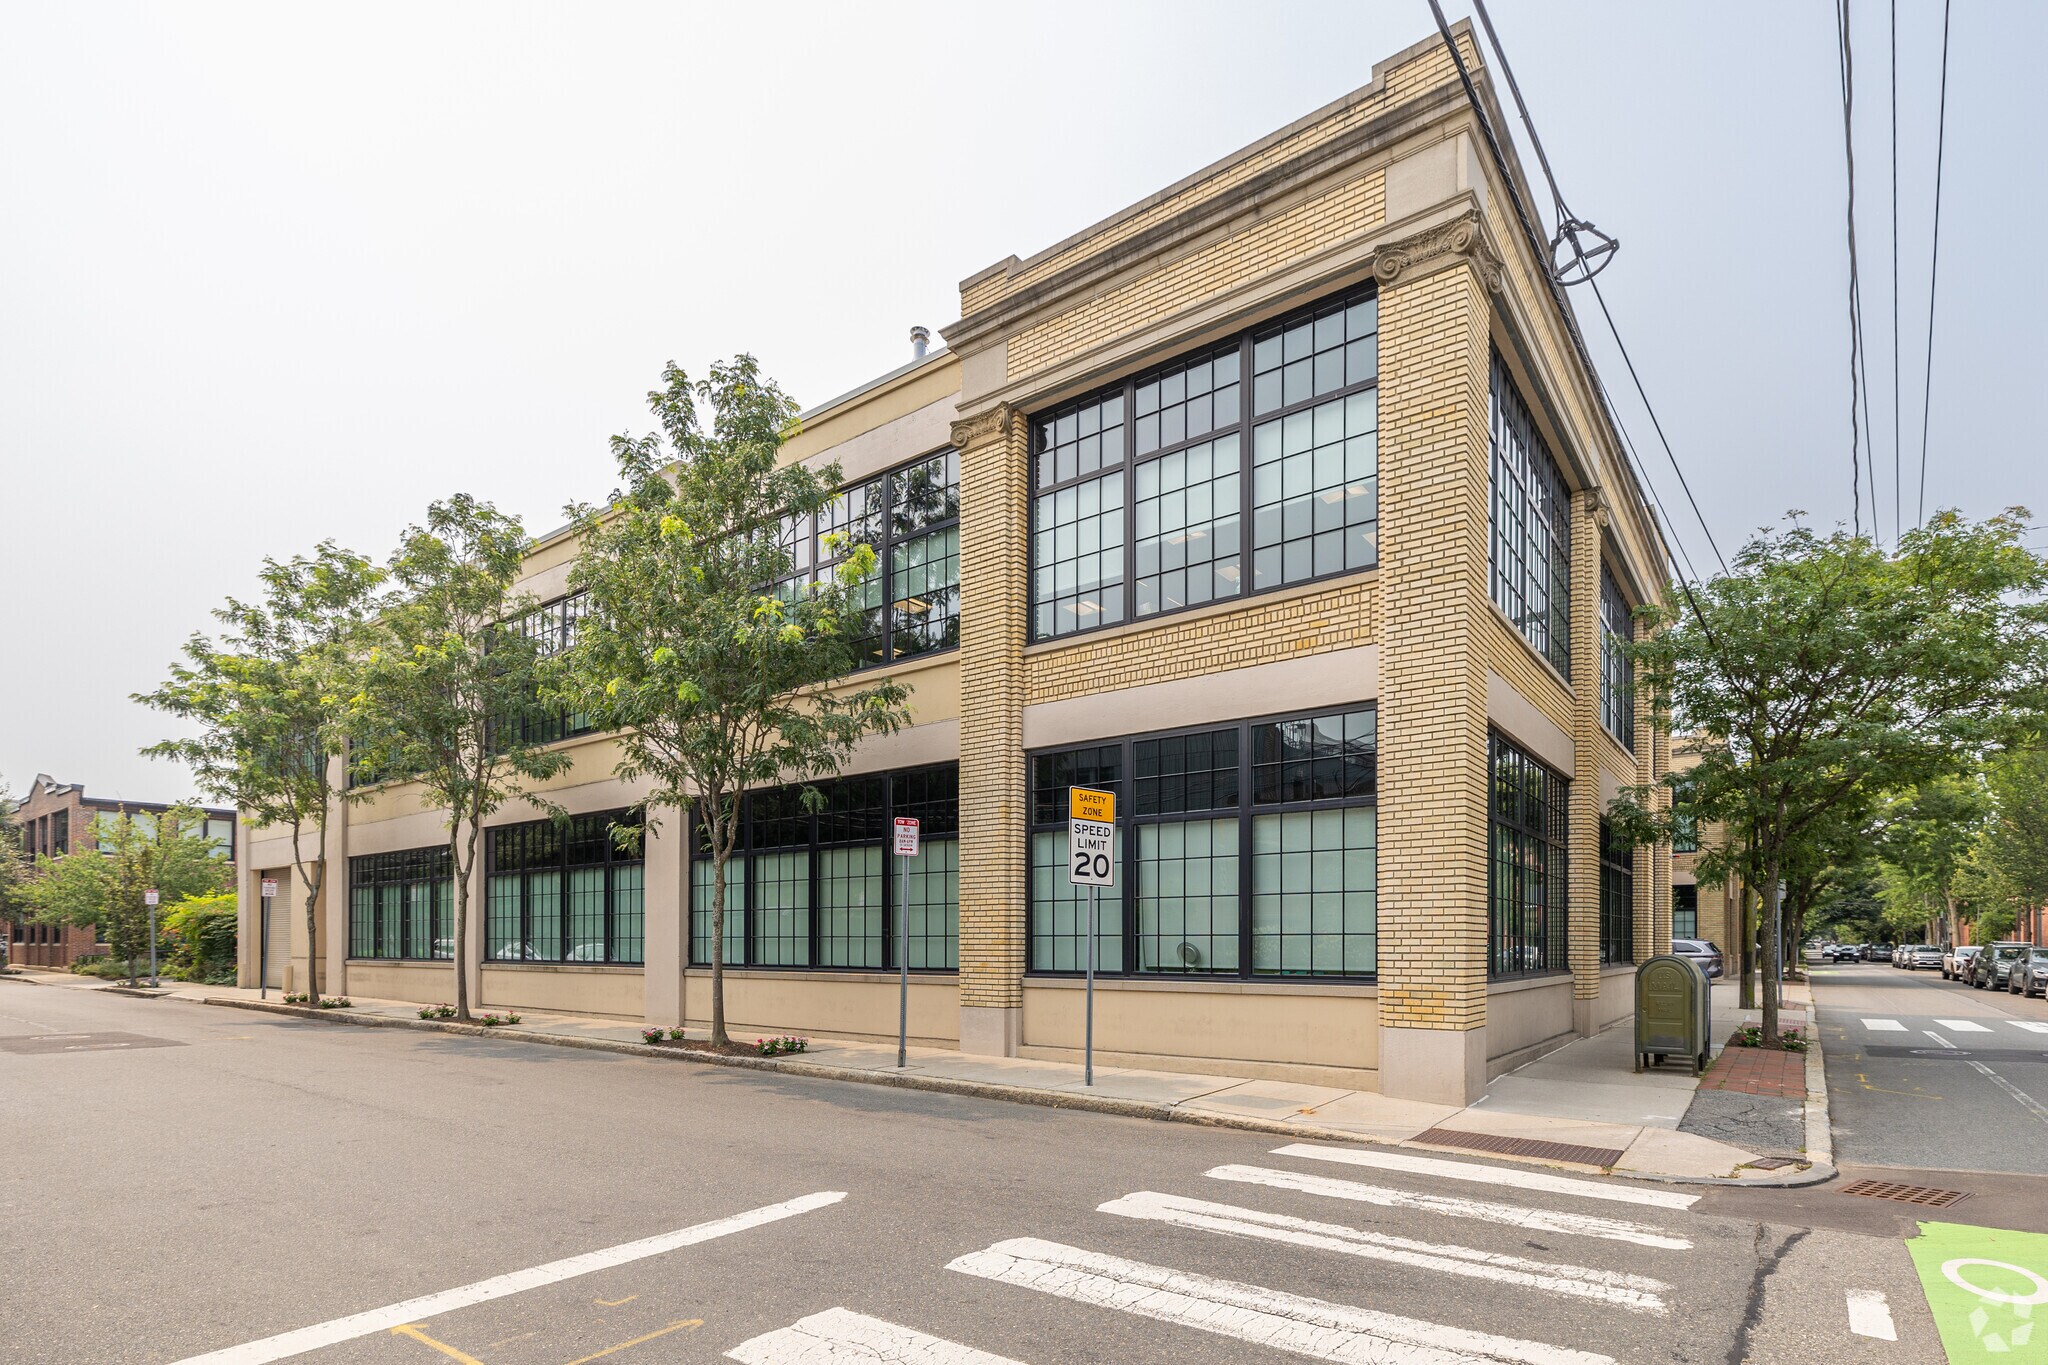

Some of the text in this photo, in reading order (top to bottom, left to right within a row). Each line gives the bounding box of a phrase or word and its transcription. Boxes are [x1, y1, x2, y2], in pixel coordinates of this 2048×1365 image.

[1078, 793, 1107, 805] SAFETY
[1082, 806, 1103, 817] ZONE
[1074, 823, 1111, 838] SPEED
[1077, 837, 1107, 851] LIMIT
[1074, 851, 1110, 878] 20
